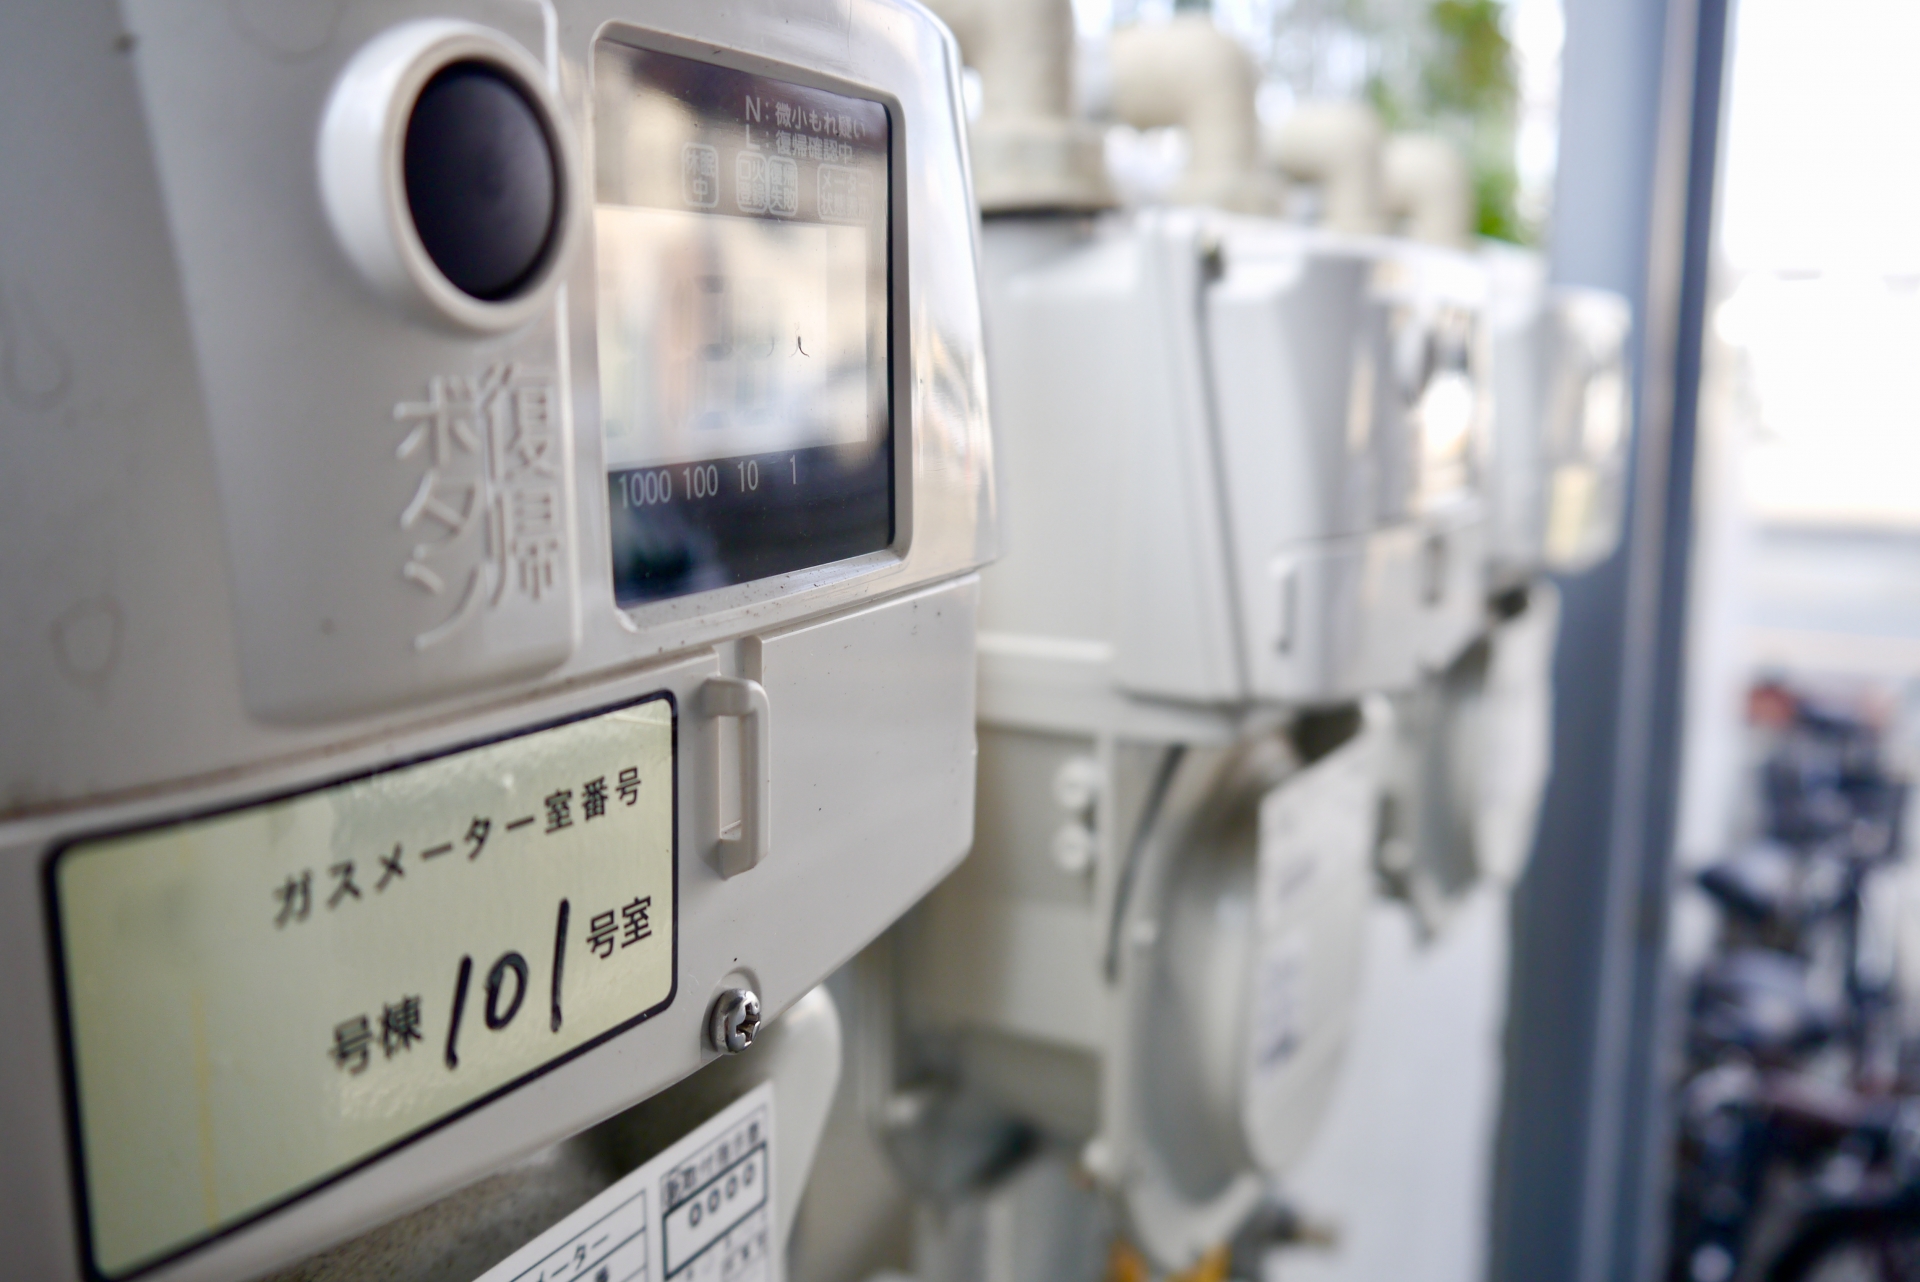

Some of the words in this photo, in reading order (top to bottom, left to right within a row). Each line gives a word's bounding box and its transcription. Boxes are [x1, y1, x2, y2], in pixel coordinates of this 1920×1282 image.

[692, 177, 709, 202] 中
[770, 186, 796, 211] 失敗
[392, 373, 484, 651] ボタン
[477, 362, 563, 608] 復帰
[618, 470, 672, 509] 1000
[683, 464, 719, 500] 100
[737, 459, 759, 492] 10
[789, 454, 797, 485] 1
[273, 766, 642, 930] ガスメーター室番号
[329, 994, 424, 1077] 号棟
[444, 897, 570, 1071] 101
[586, 895, 653, 960] 号室
